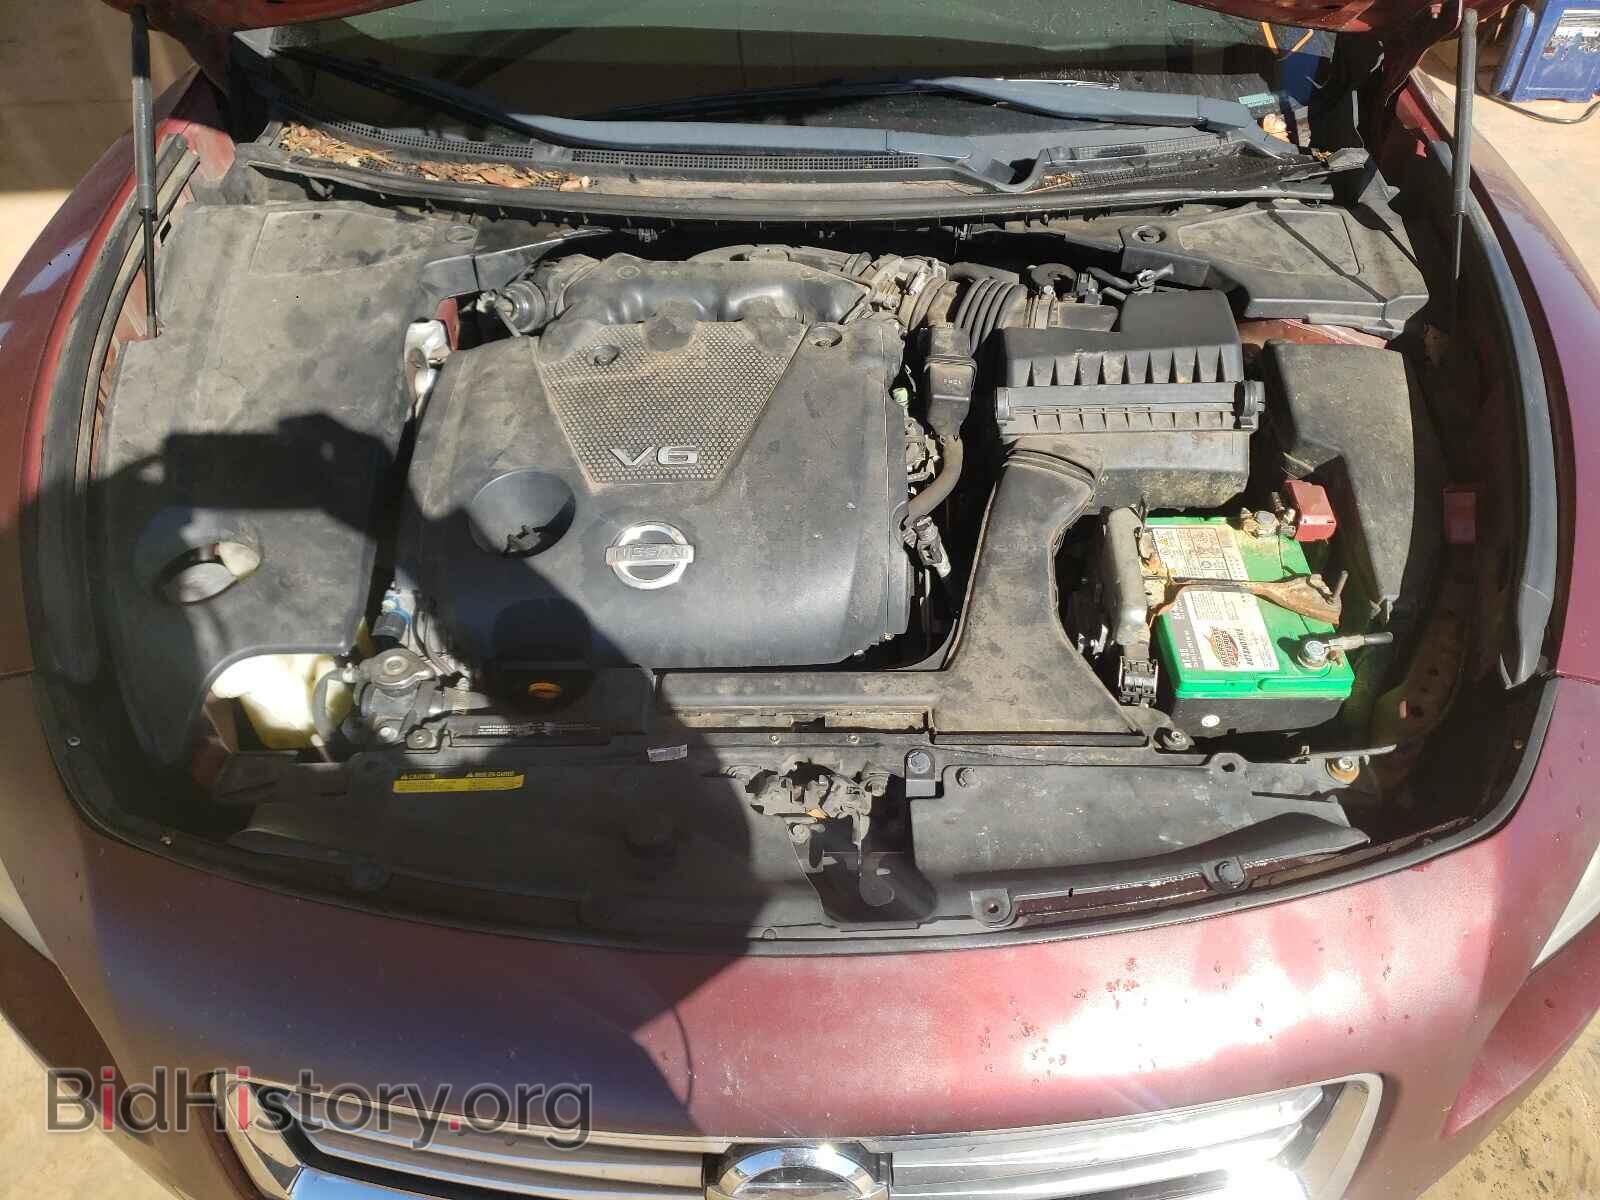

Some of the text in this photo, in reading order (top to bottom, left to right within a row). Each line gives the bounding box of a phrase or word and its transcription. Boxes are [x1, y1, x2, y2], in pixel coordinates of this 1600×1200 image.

[607, 446, 698, 467] V6
[610, 545, 690, 562] NISSAN
[1210, 626, 1230, 667] INTERSTATE
[1221, 630, 1238, 666] BATTERIES
[1236, 628, 1254, 666] AUTOMOTIVE
